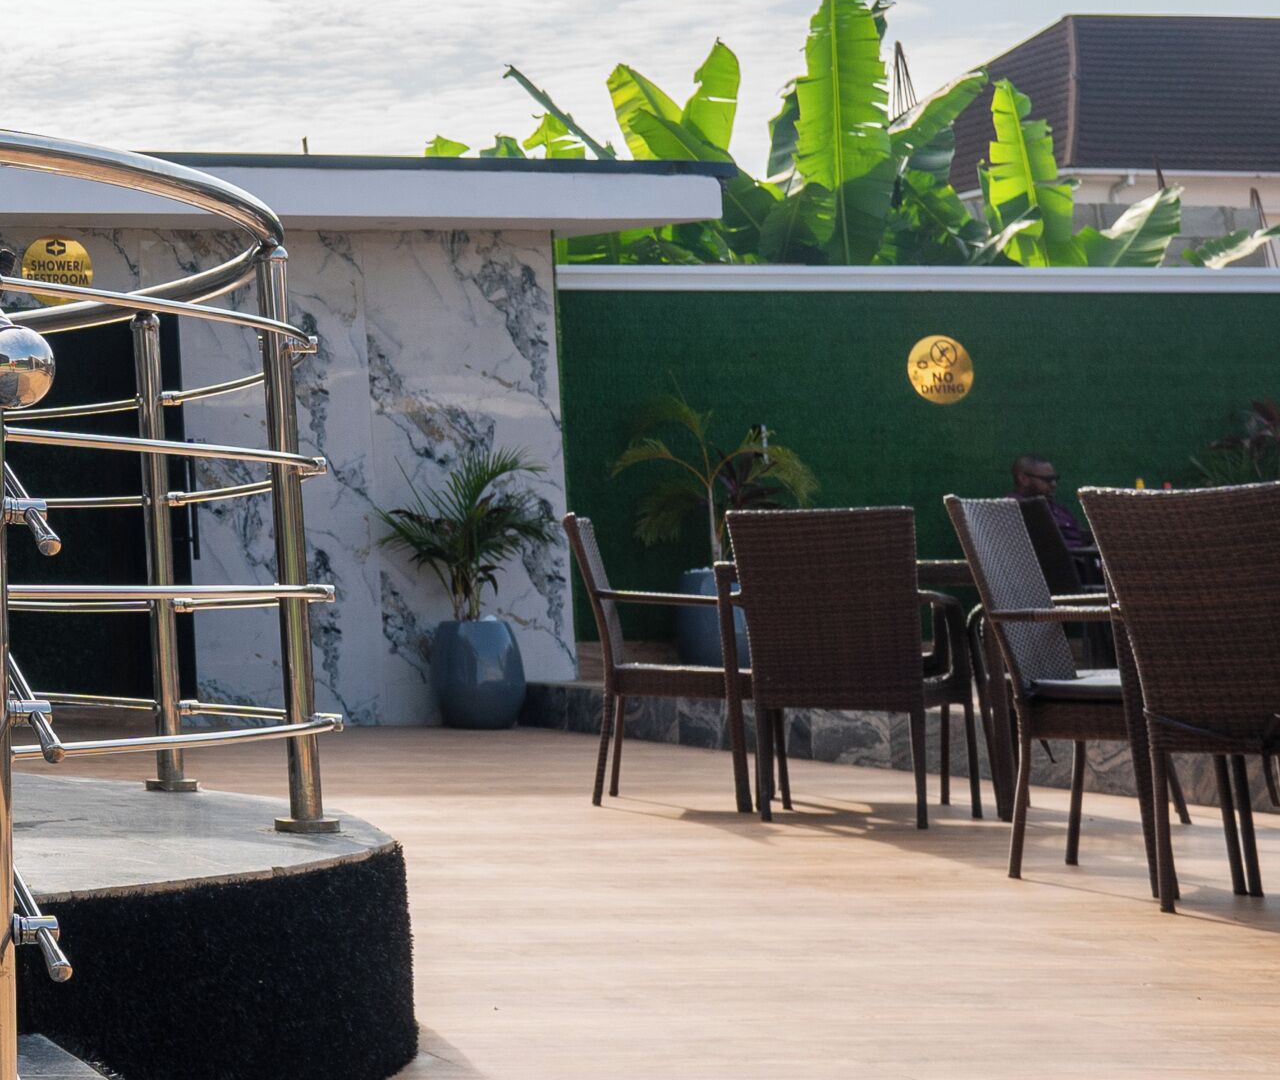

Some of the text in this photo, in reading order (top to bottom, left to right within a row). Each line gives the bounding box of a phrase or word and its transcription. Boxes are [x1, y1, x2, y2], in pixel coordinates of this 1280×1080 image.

[31, 260, 83, 272] SHOWER/
[932, 371, 954, 384] NO
[921, 383, 965, 394] DIVING
